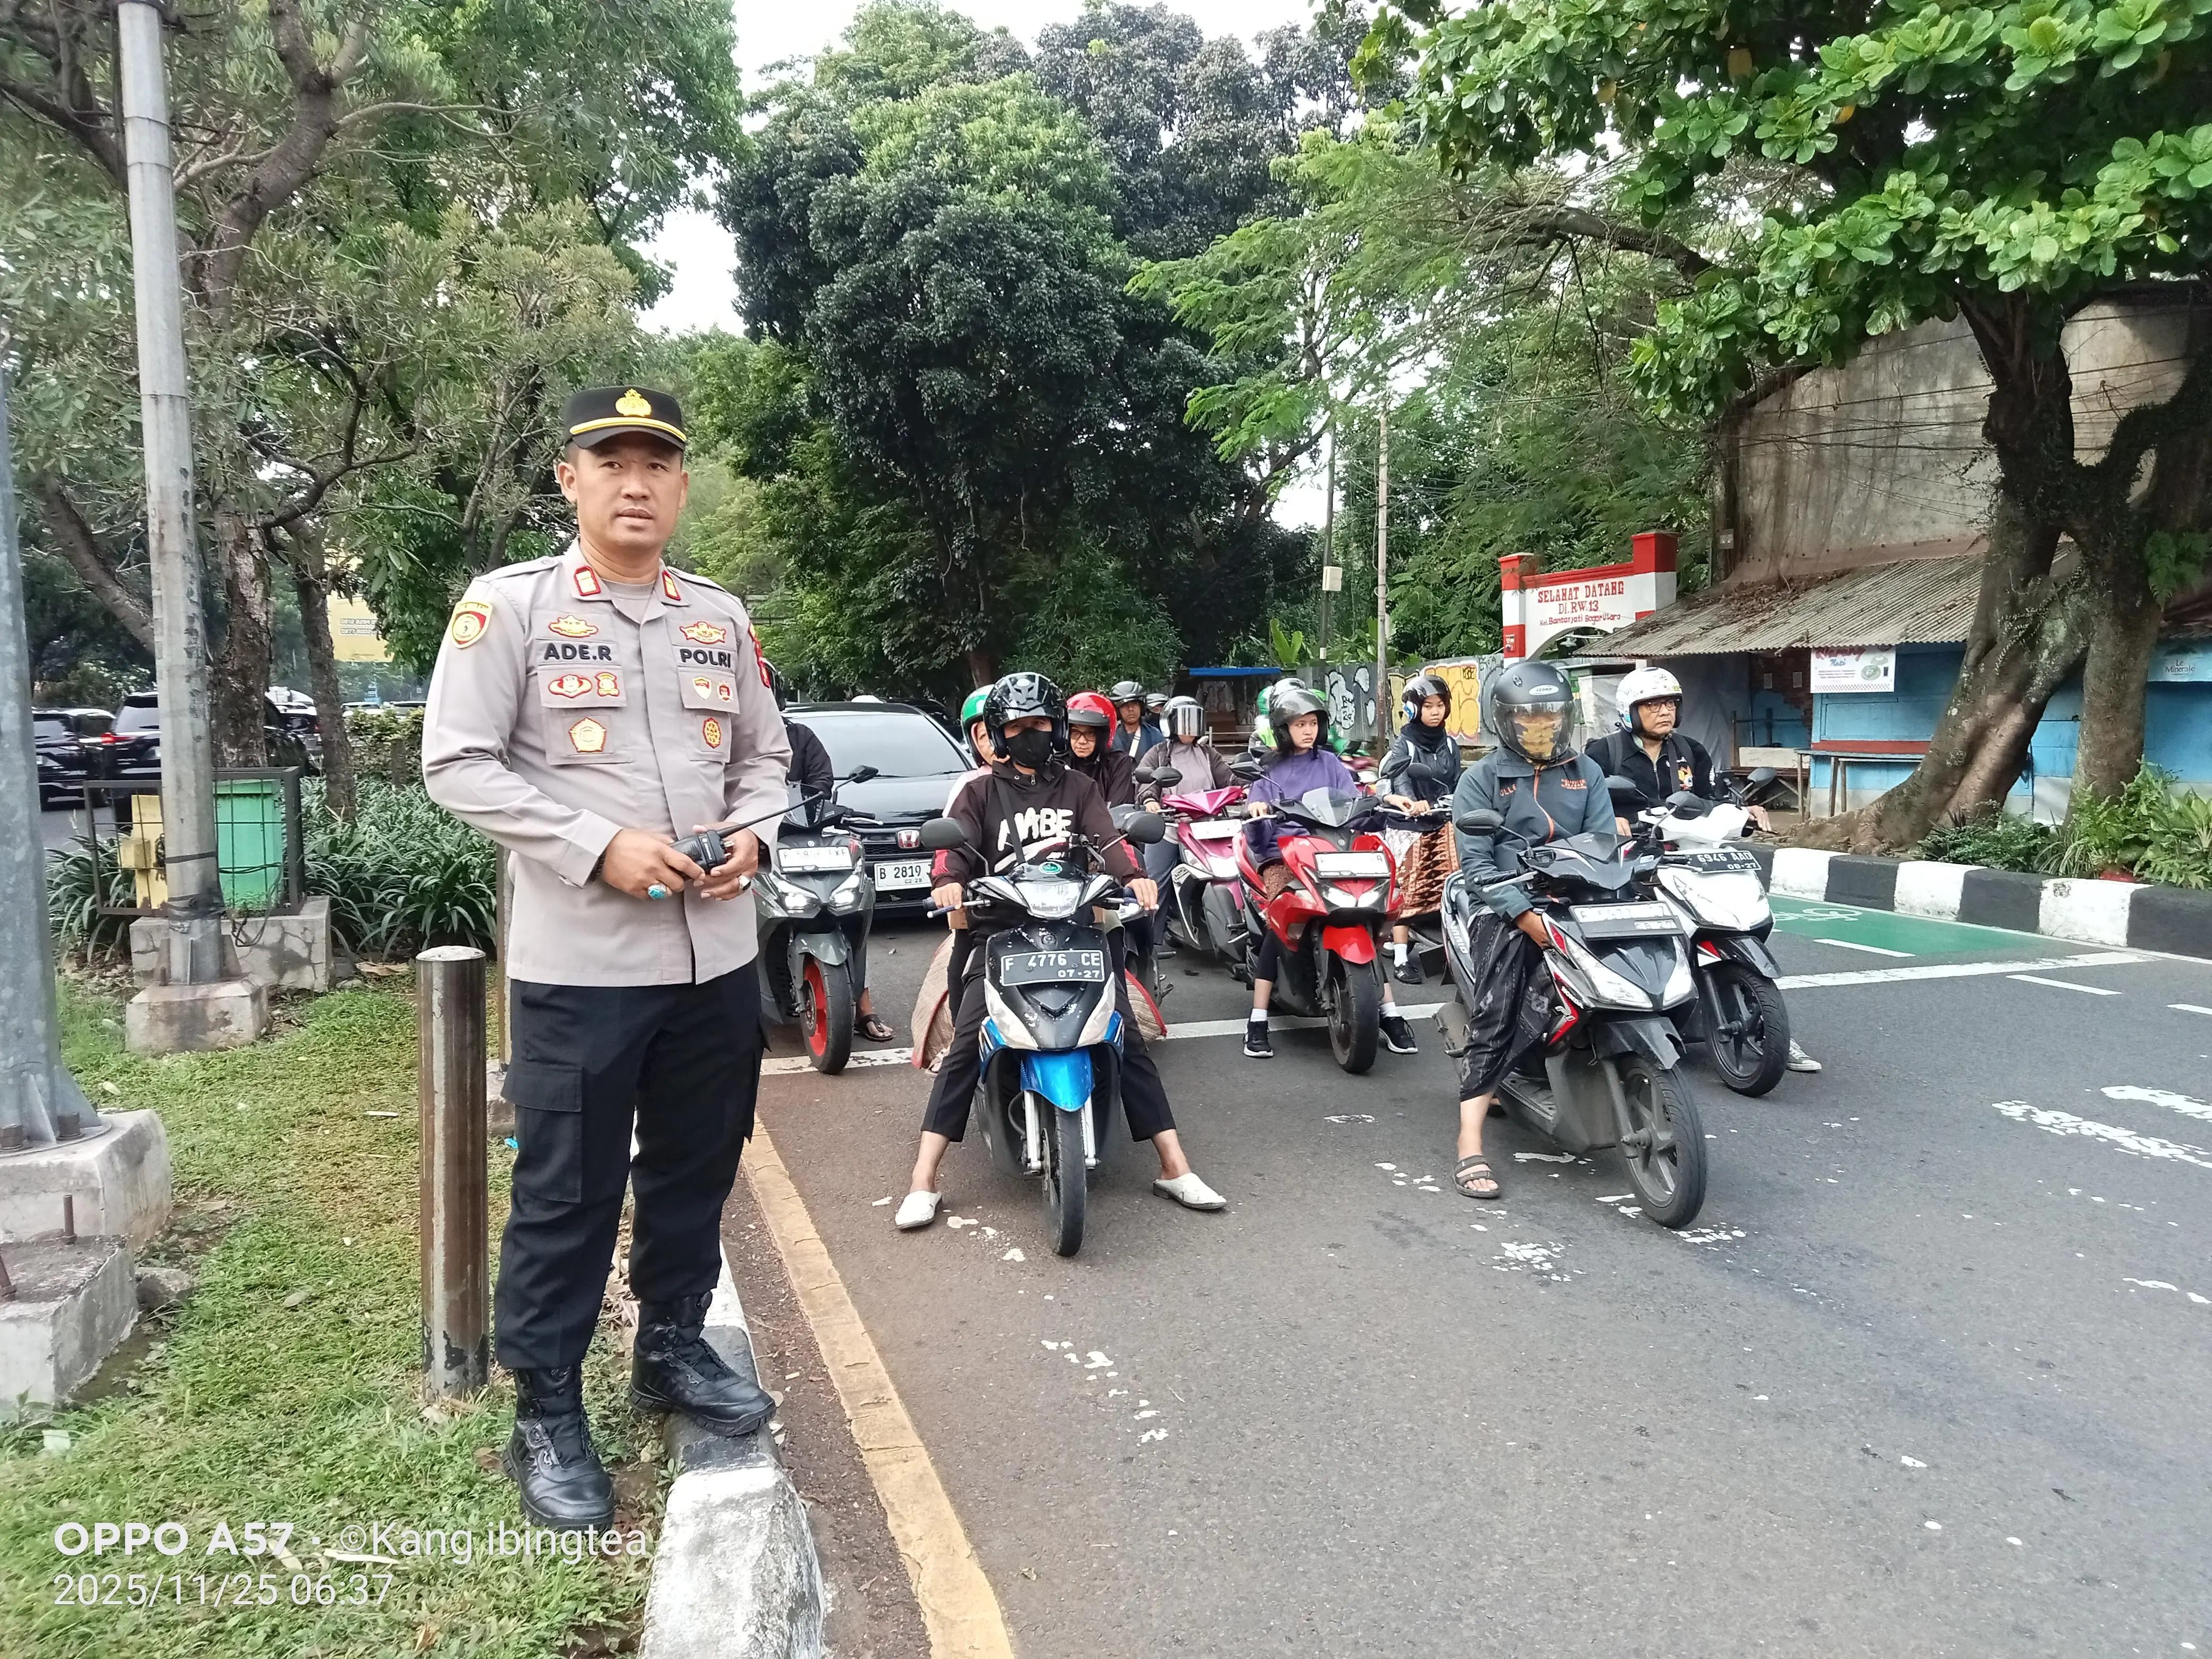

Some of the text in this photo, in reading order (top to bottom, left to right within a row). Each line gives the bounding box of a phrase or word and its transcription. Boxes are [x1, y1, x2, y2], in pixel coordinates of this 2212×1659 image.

[543, 643, 611, 661] ADE.R
[680, 649, 731, 668] POLRI
[1697, 853, 1728, 862] 6946
[879, 868, 886, 879] B
[894, 865, 921, 878] 2819
[1005, 953, 1101, 971] F 4776 CE
